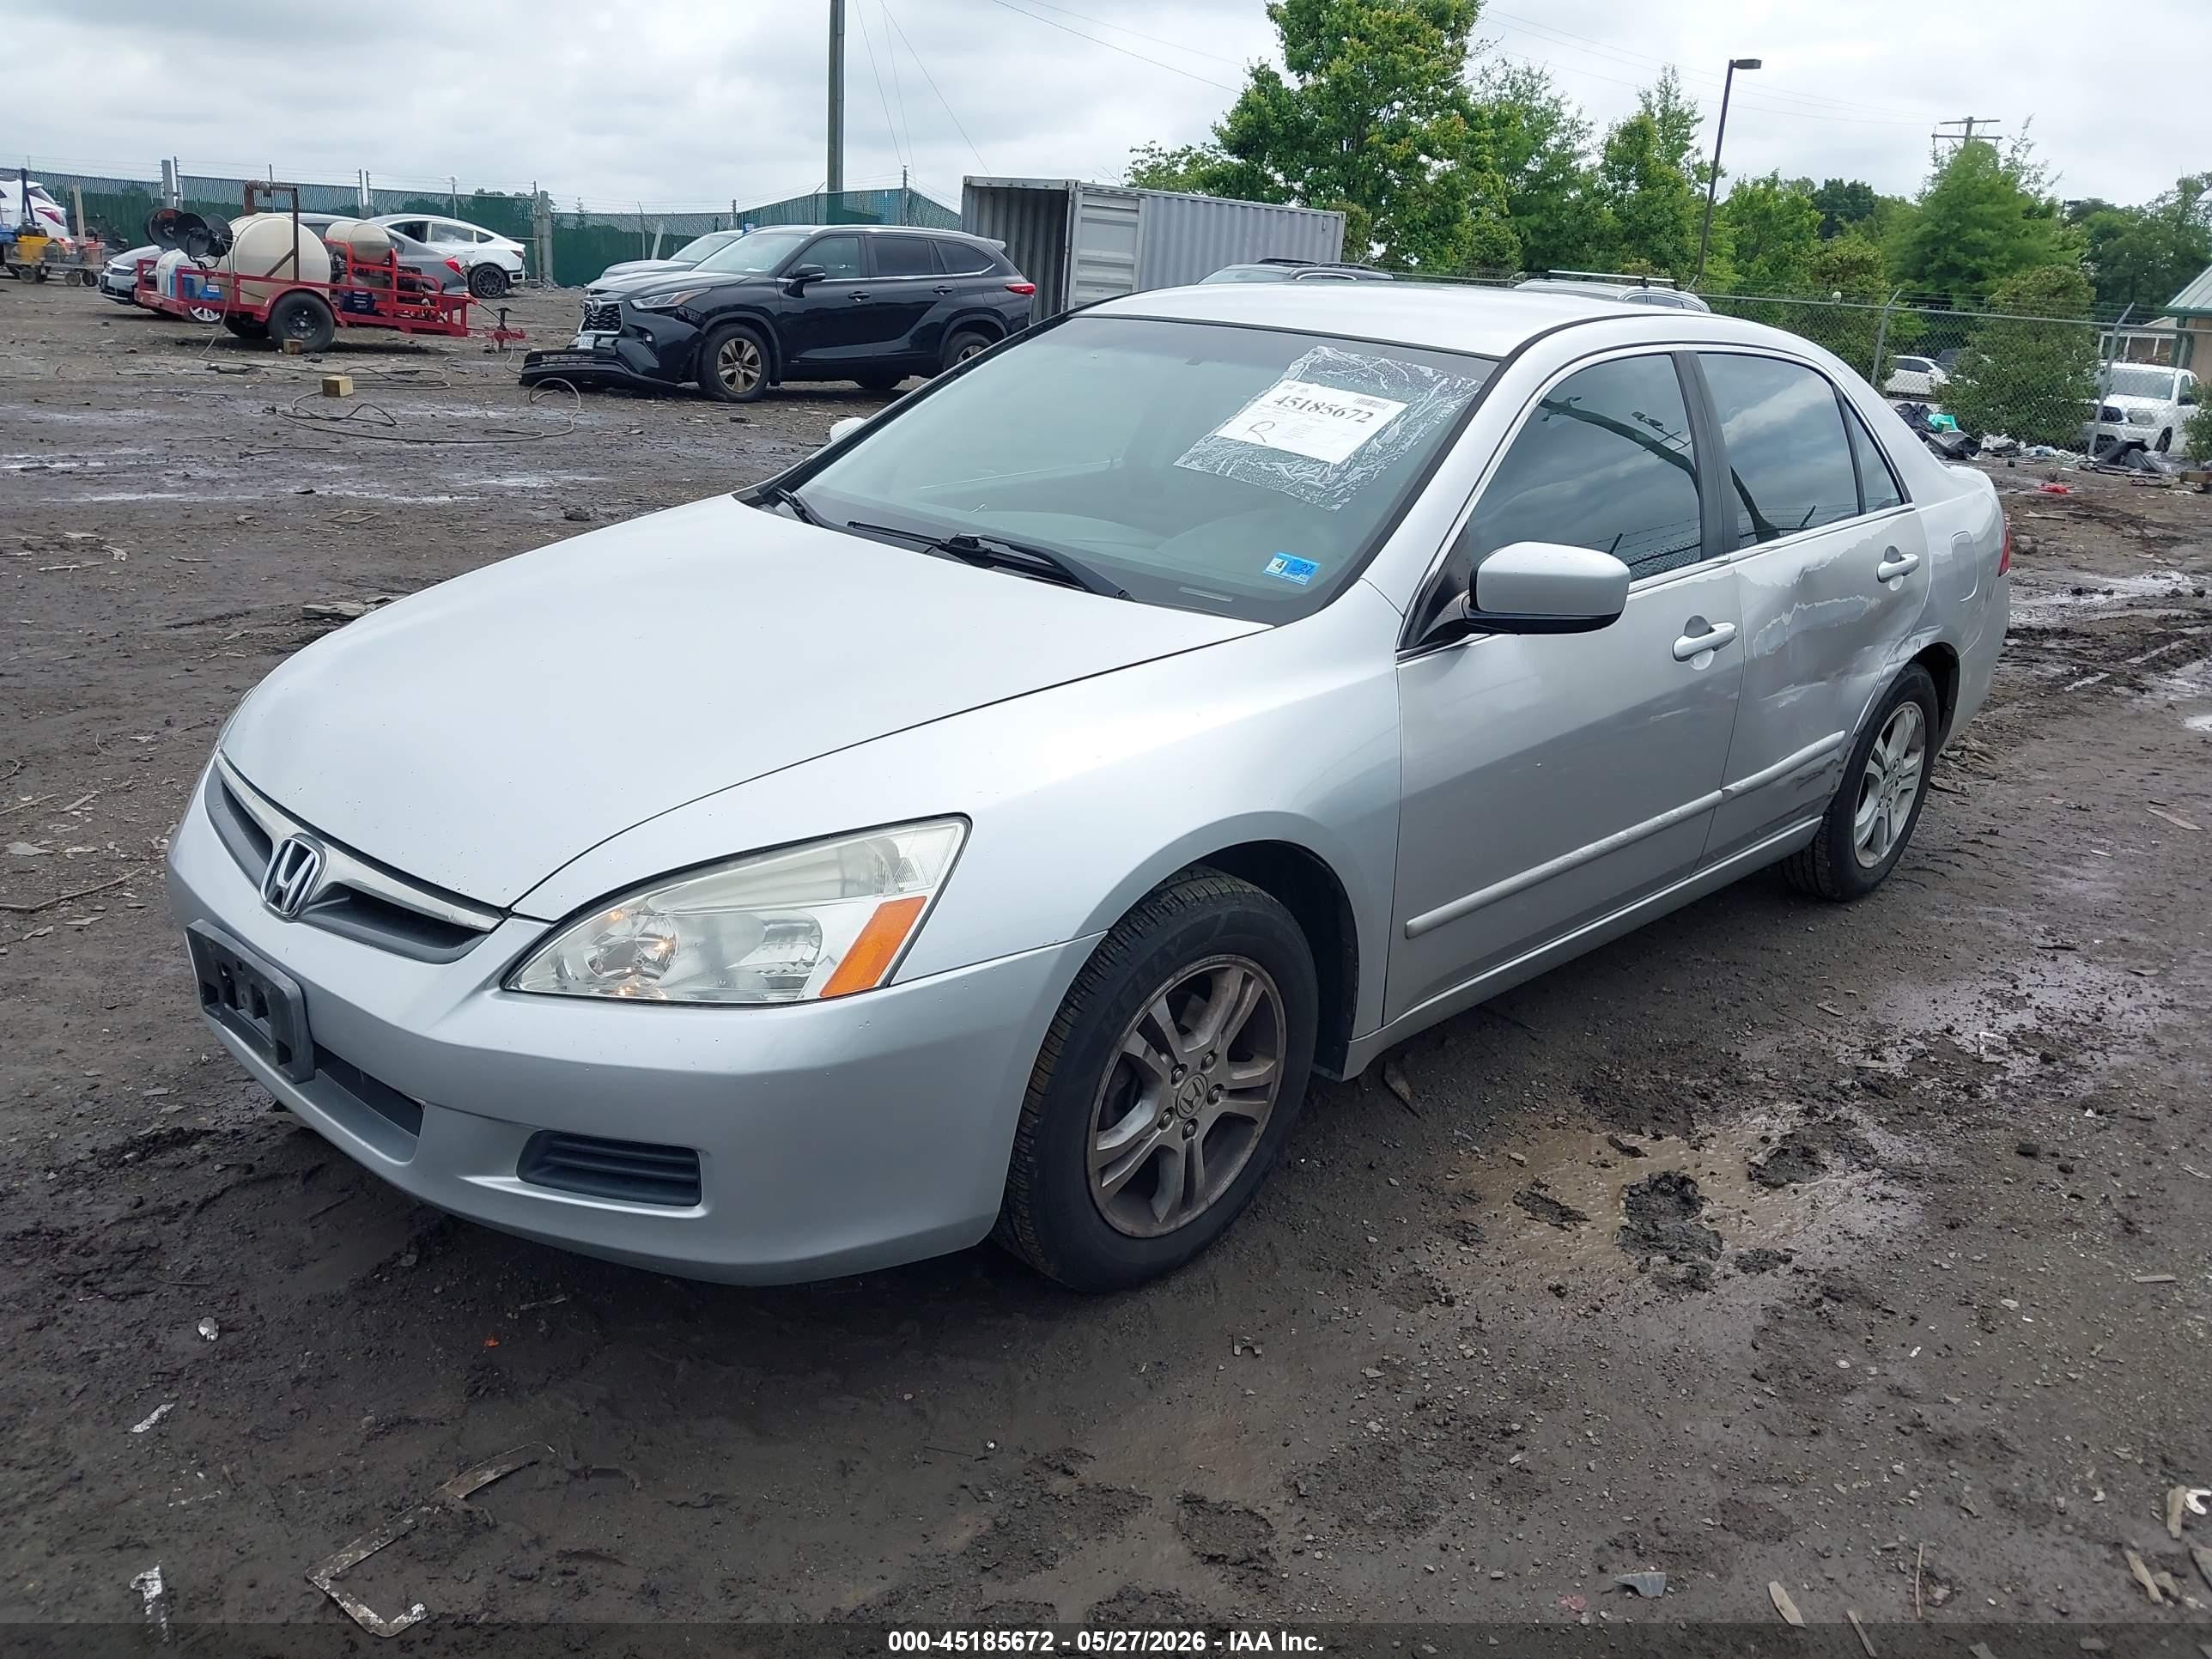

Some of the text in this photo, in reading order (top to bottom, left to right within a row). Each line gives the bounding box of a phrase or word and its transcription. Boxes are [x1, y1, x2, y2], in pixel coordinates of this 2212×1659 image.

[1274, 395, 1374, 423] 45185672
[1275, 560, 1314, 574] 4 27
